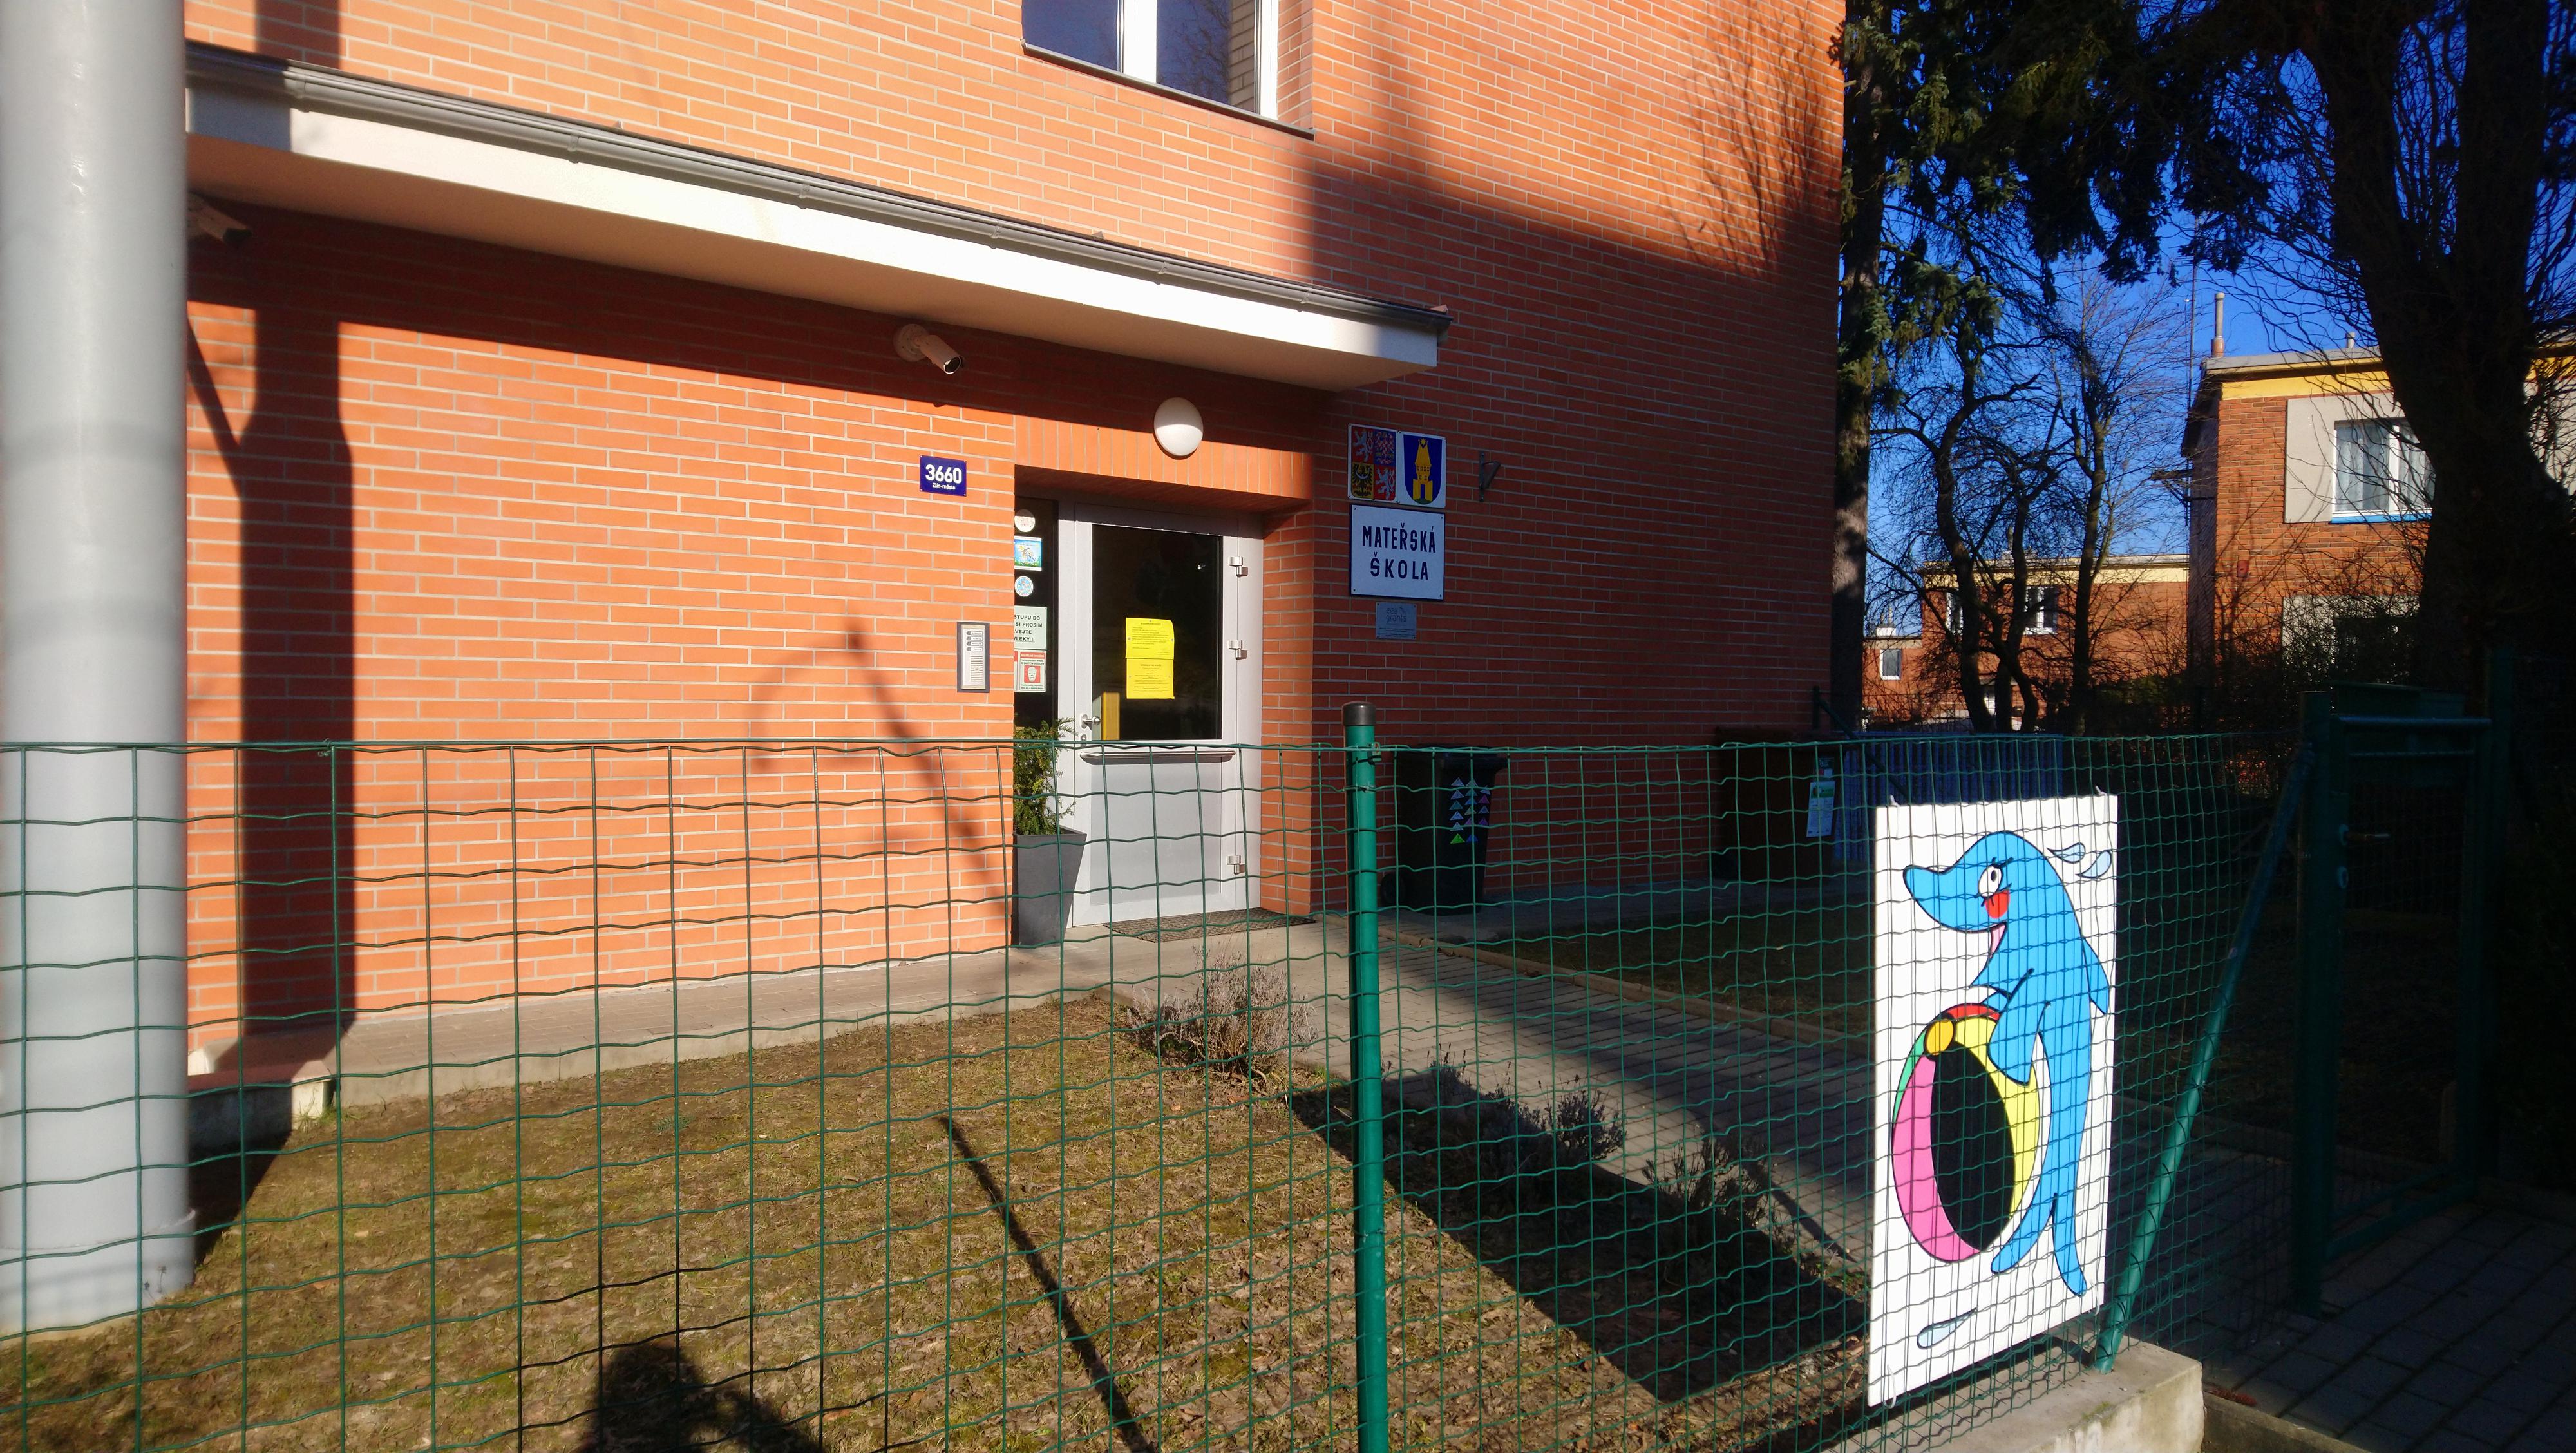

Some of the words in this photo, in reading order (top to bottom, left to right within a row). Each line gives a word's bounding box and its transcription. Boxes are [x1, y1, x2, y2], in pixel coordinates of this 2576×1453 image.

[925, 464, 962, 484] 3660
[1362, 522, 1435, 553] MATEŘSKÁ
[1370, 551, 1428, 580] ŠKOLA
[1386, 614, 1407, 623] grants
